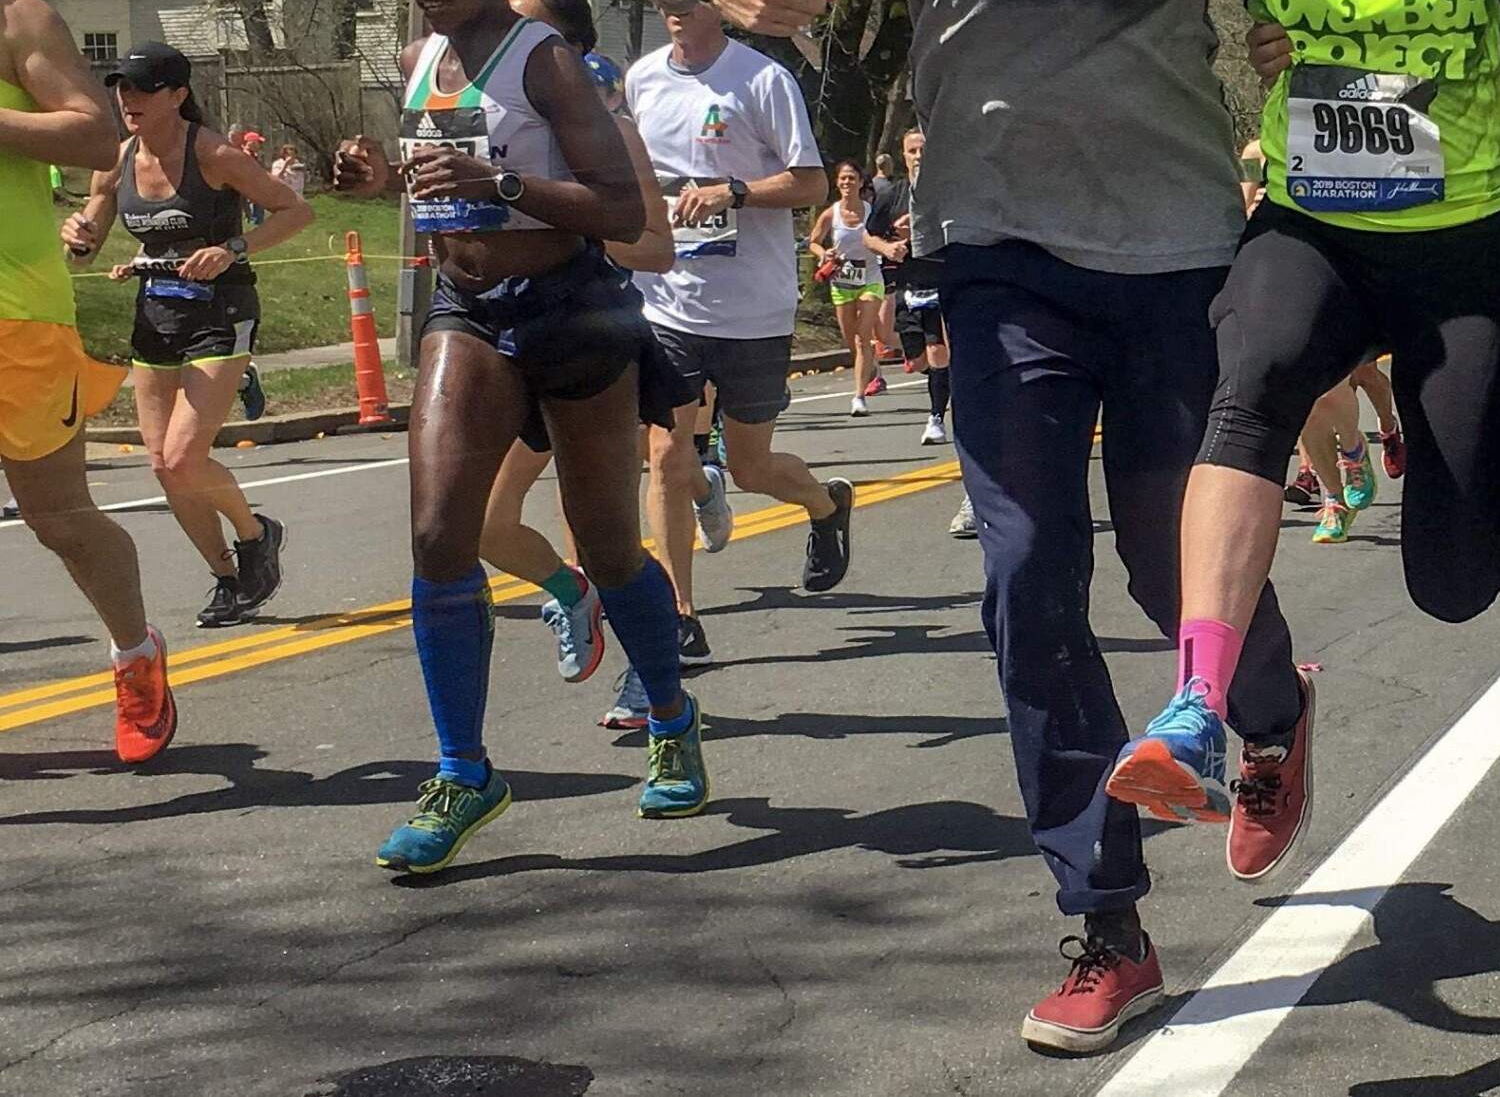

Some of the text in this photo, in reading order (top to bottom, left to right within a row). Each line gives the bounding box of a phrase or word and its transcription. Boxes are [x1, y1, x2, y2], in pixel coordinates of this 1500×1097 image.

[1286, 30, 1477, 80] ROJECT
[1312, 103, 1415, 156] 9669
[1291, 155, 1304, 172] 2
[1312, 180, 1334, 190] 2019
[1335, 180, 1377, 191] BOSTON
[1312, 189, 1377, 200] MARATHON
